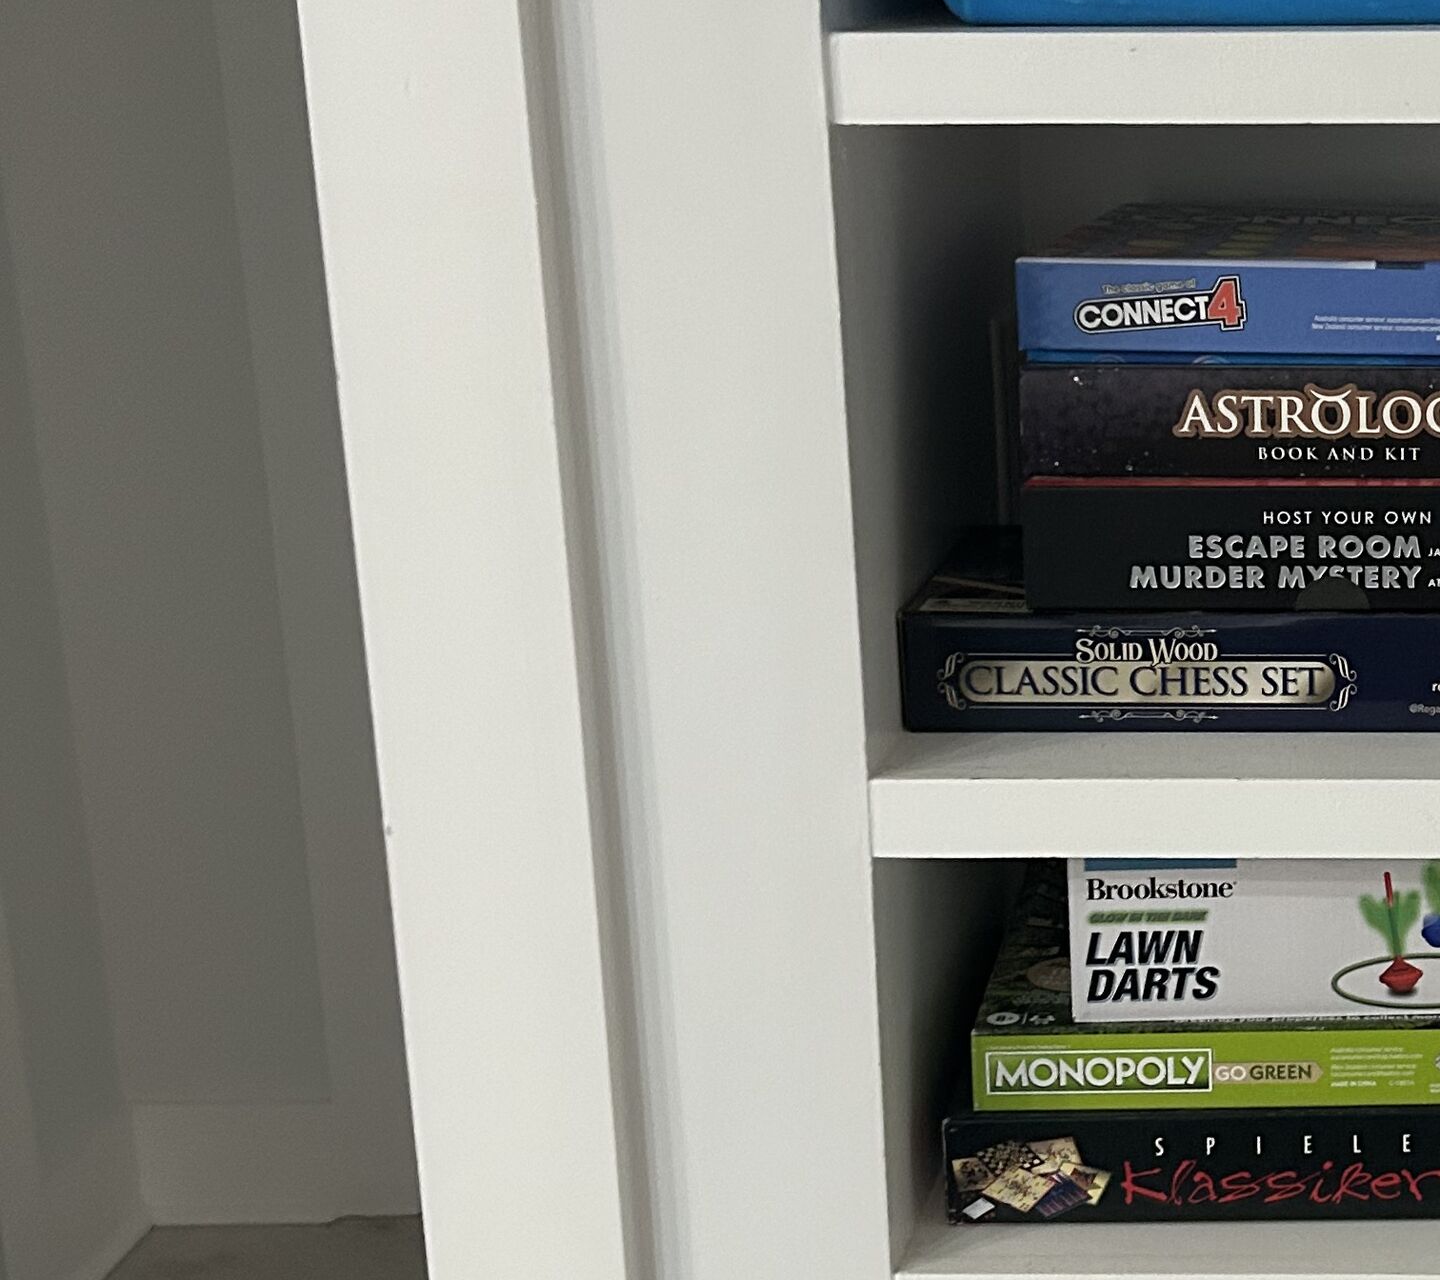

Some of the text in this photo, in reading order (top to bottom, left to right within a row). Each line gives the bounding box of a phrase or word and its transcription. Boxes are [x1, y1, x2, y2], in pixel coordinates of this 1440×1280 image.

[1078, 280, 1242, 329] CONNECT 4
[1258, 446, 1421, 461] BOOK AND KIT
[1263, 511, 1432, 525] HOST YOUR OWN
[1187, 534, 1422, 559] ESCAPE ROOM
[1129, 565, 1266, 589] MURDER
[964, 665, 1324, 697] CLASSIC CHESS SET
[1086, 877, 1234, 900] Brookstone
[1086, 930, 1203, 965] LAWN
[1087, 966, 1220, 1002] DARTS
[995, 1056, 1205, 1087] MONOPOLY
[1215, 1066, 1247, 1081] GO
[1249, 1064, 1312, 1080] GREEN
